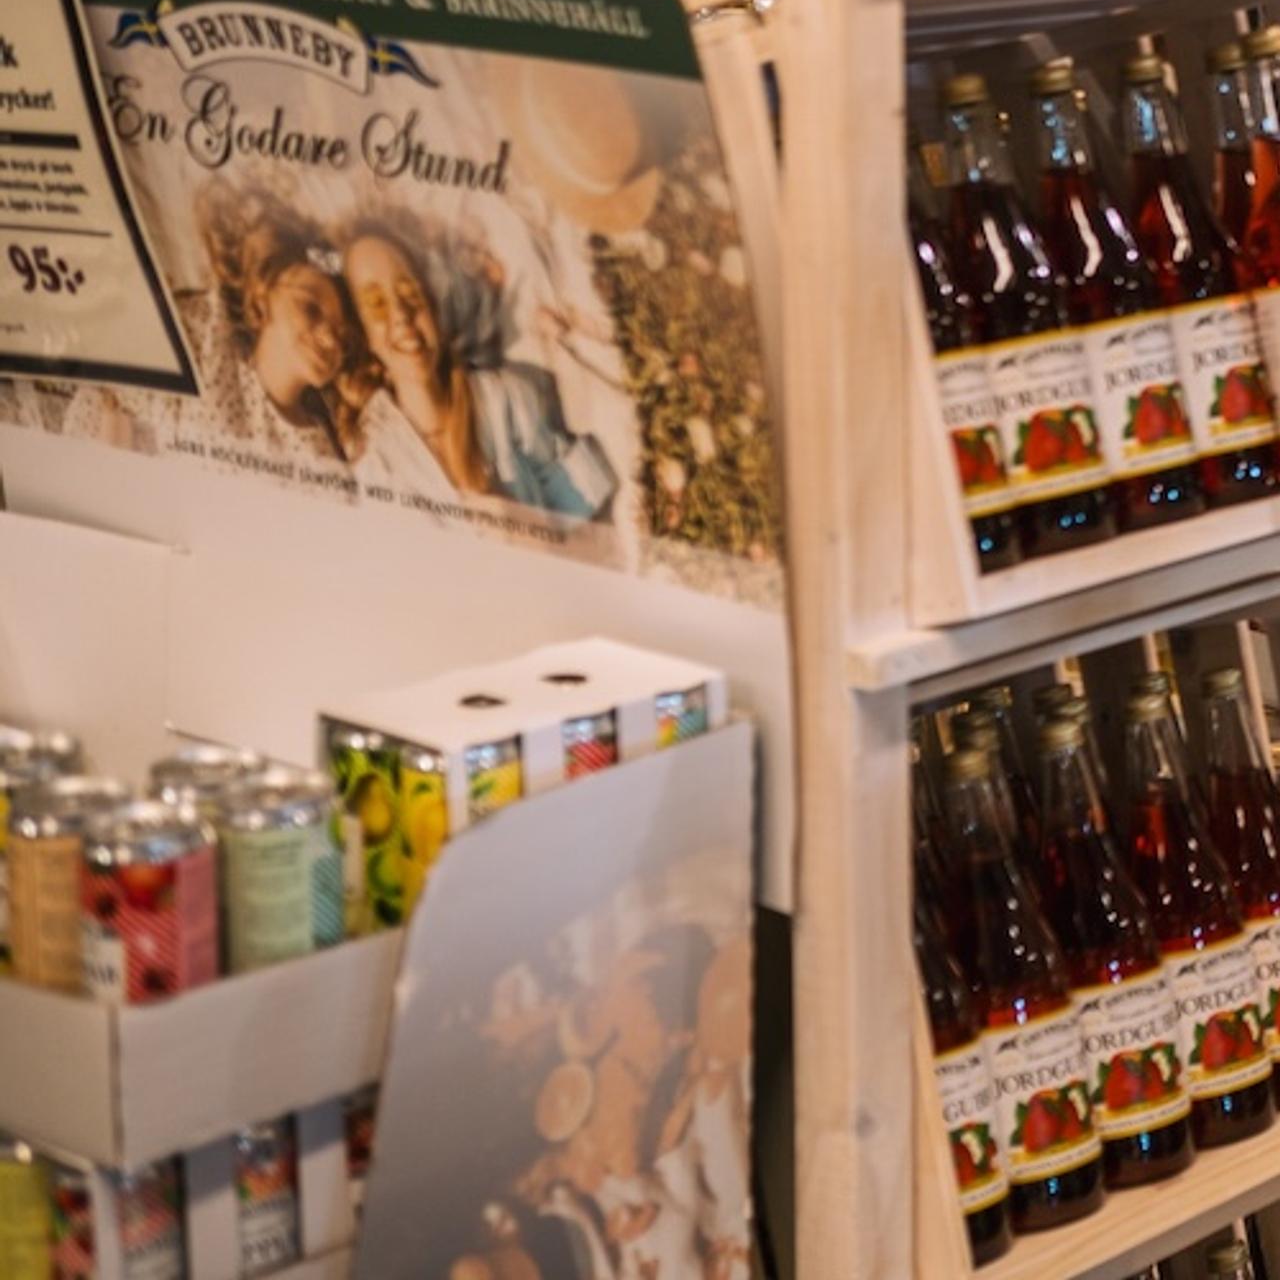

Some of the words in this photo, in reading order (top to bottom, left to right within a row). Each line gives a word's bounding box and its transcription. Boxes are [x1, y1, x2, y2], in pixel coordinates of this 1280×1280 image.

[177, 11, 355, 77] BRUNNEBY
[103, 73, 174, 146] En
[181, 73, 349, 170] Godare
[361, 110, 511, 194] Stund
[8, 243, 86, 295] 95:-
